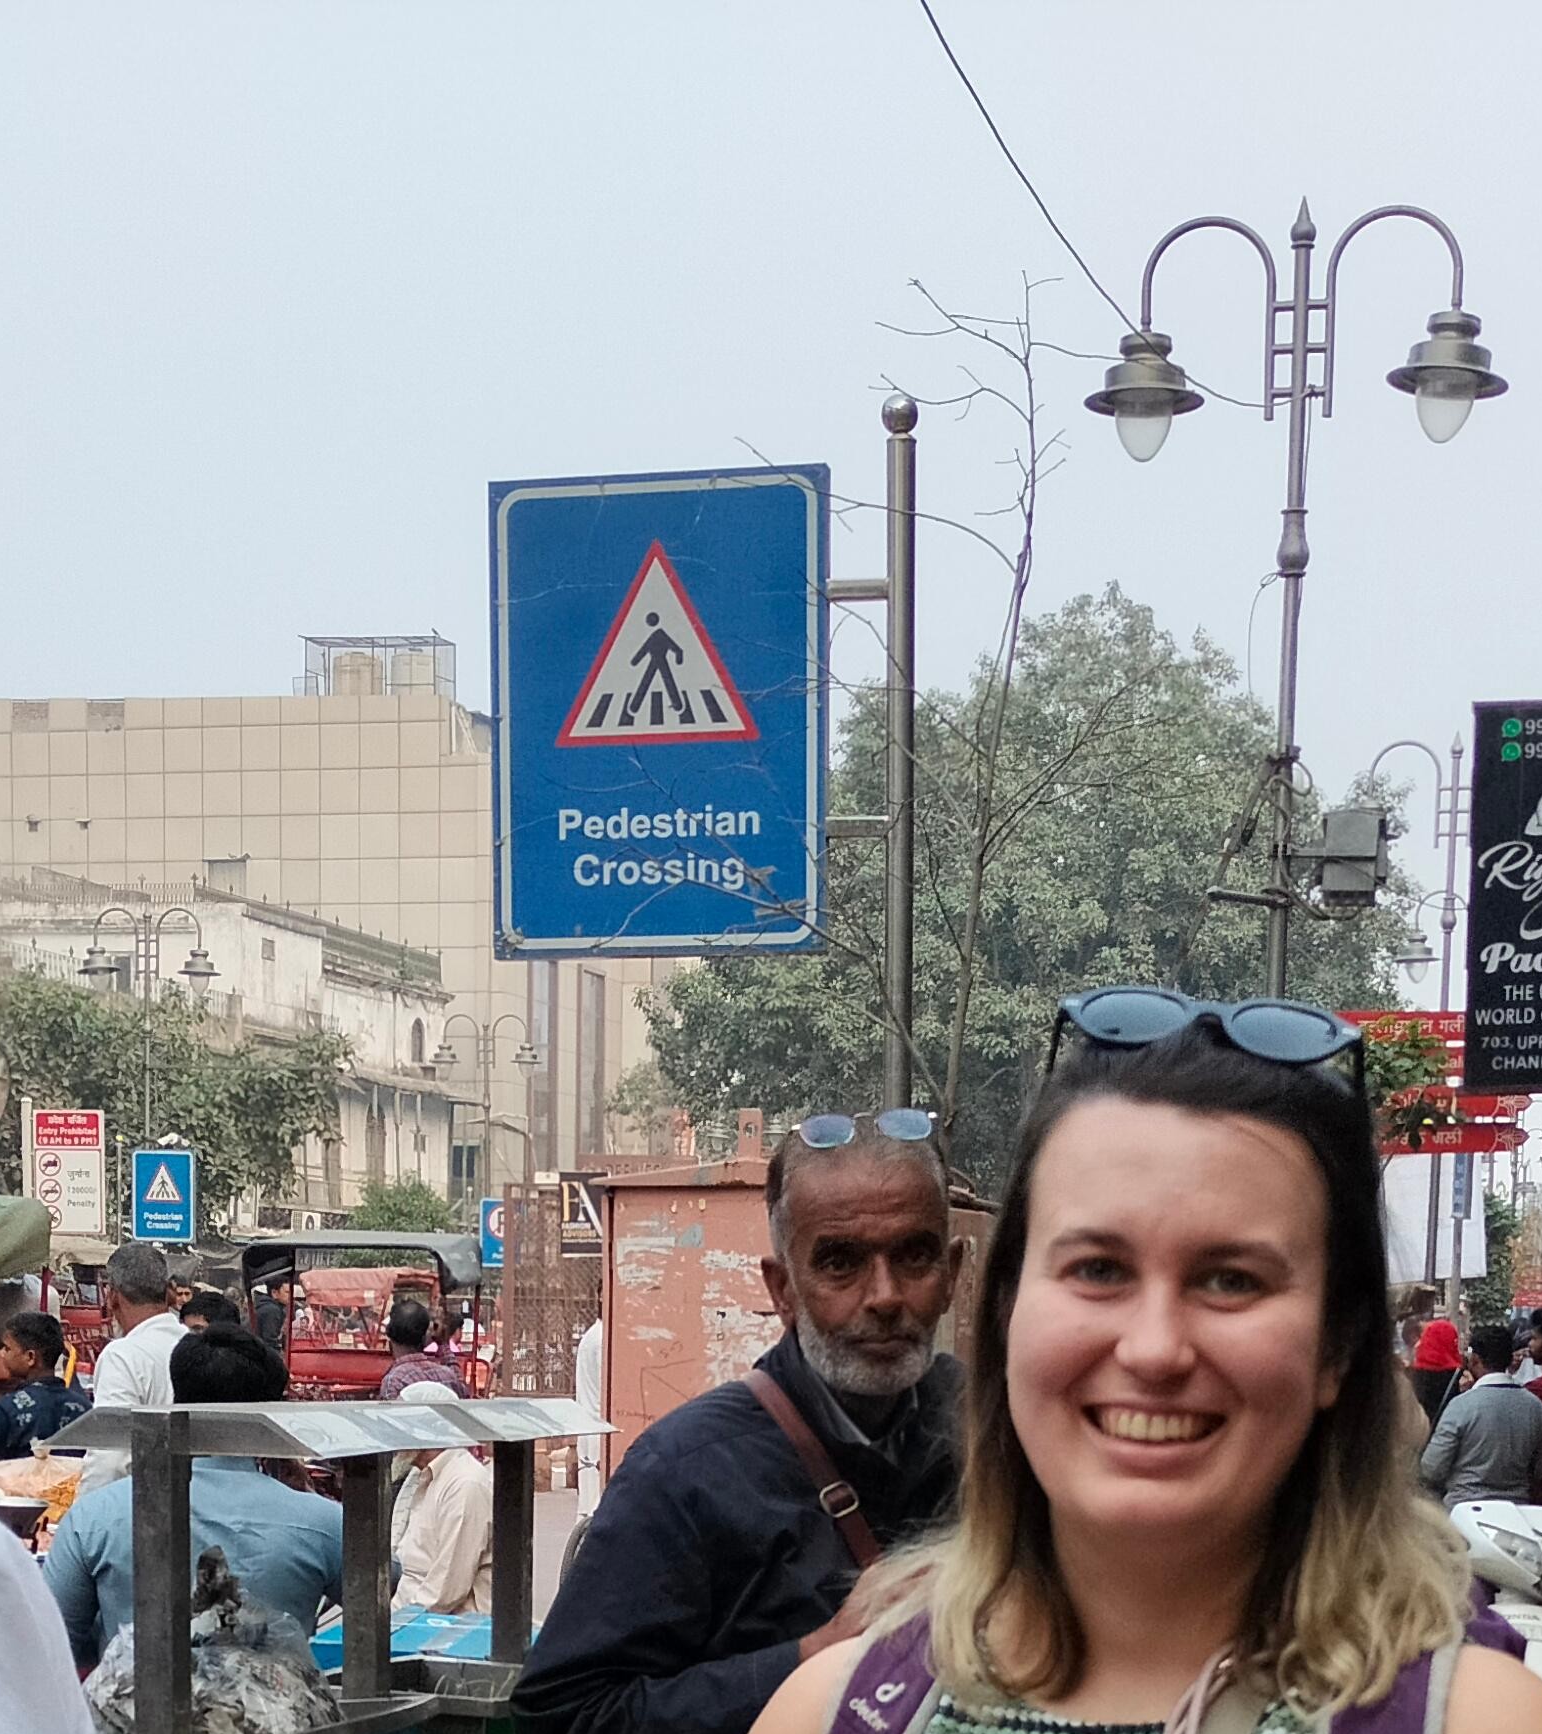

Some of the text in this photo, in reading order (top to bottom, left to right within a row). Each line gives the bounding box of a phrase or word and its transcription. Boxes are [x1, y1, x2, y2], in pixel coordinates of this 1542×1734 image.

[559, 805, 760, 841] Pedestrian
[574, 852, 745, 889] Crossing
[1503, 984, 1535, 1001] THE
[1475, 1007, 1536, 1026] WORLD
